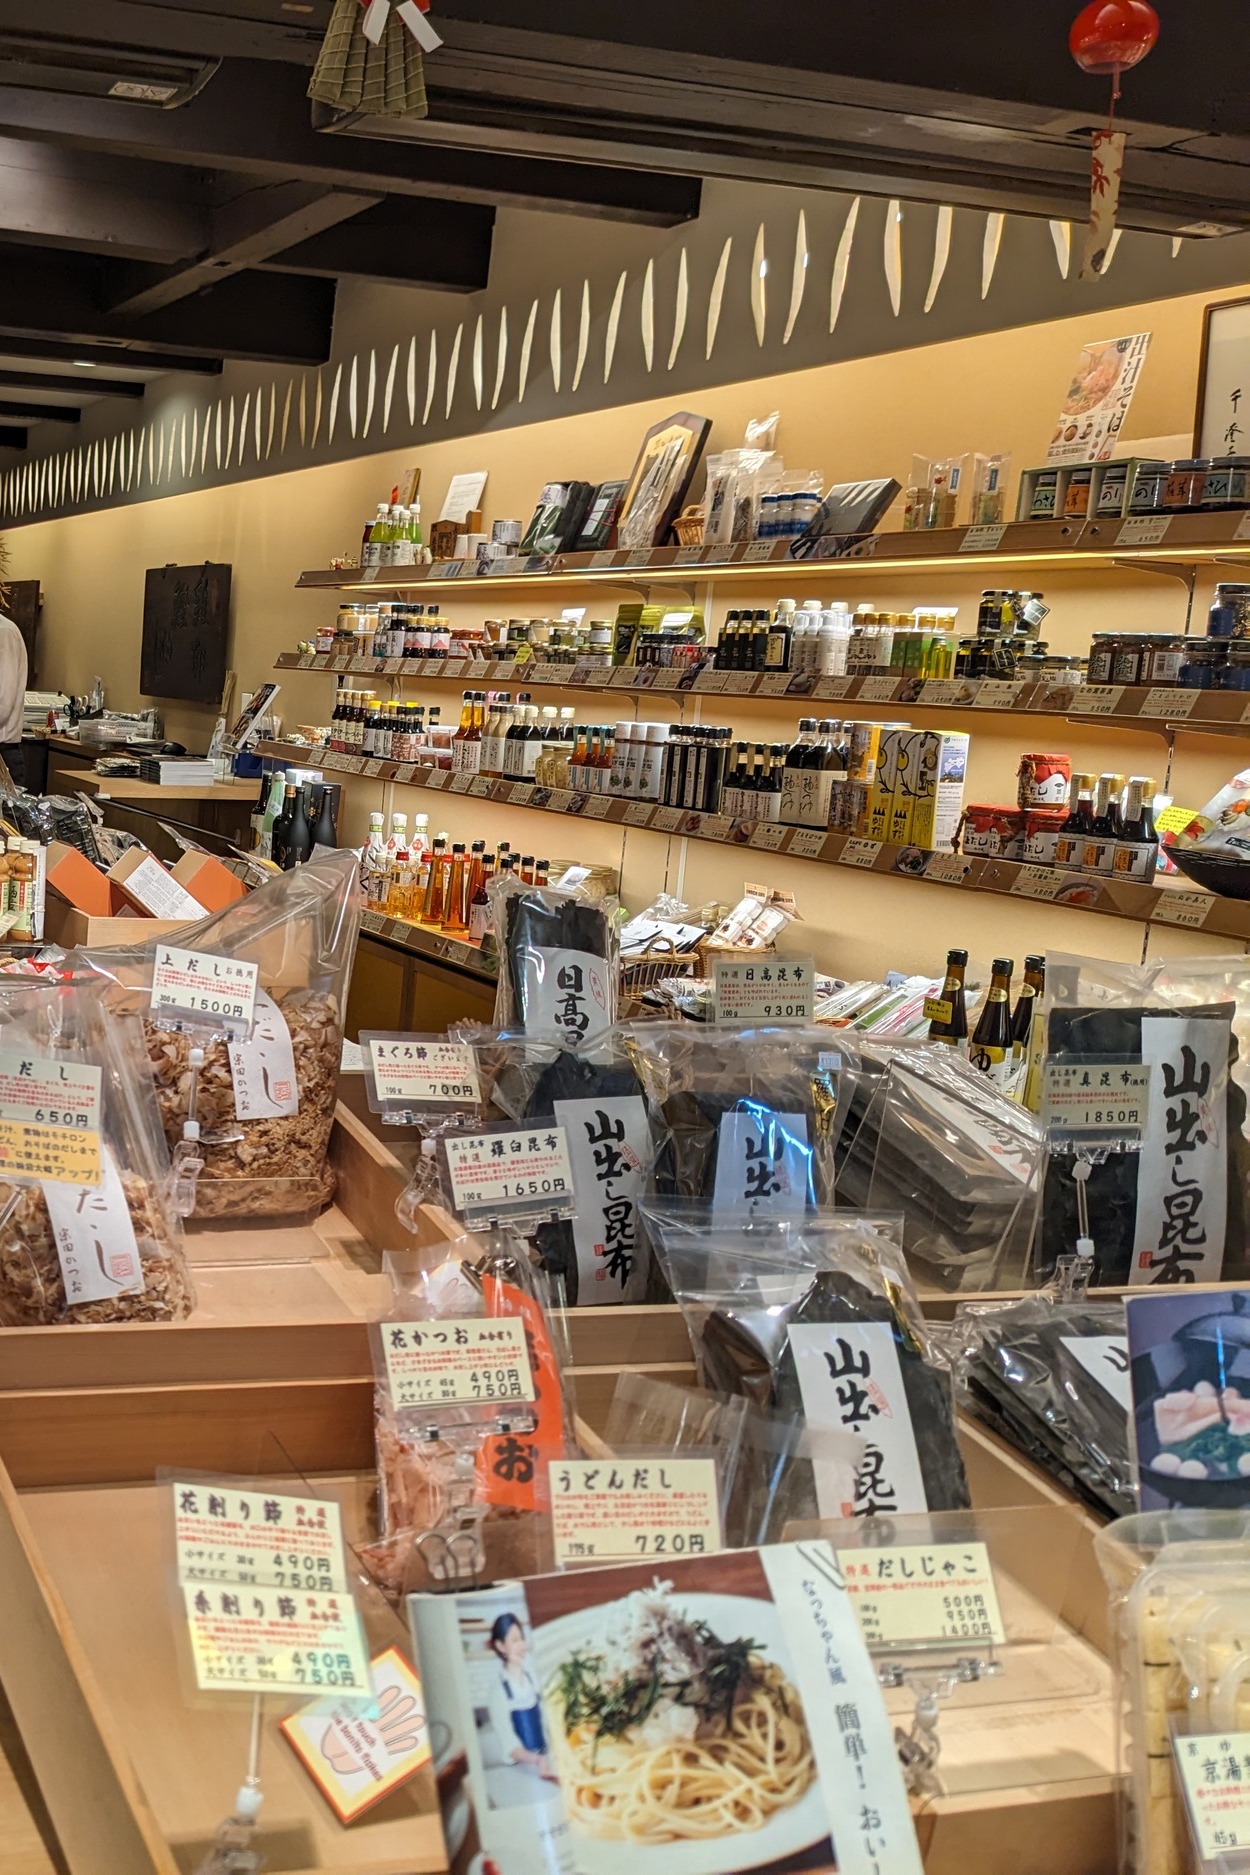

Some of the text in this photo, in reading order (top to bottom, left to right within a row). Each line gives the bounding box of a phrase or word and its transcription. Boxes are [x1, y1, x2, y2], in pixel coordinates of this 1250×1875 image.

[160, 953, 254, 979] 上だし お徳用
[745, 966, 804, 981] 日高昆布
[189, 996, 243, 1017] 1500円
[764, 1005, 805, 1016] 930円
[377, 1045, 428, 1060] まぐろ節
[1079, 1070, 1132, 1087] 真昆布
[429, 1084, 473, 1096] 700円
[35, 1109, 88, 1127] 650円
[1085, 1110, 1138, 1122] 1850円
[451, 1133, 558, 1158] 出し昆布 羅臼昆布
[458, 1152, 482, 1164] 特選
[1150, 1044, 1212, 1286] 山出し昆布
[502, 1178, 565, 1198] 1650円
[584, 1109, 635, 1290] 山出し昆布
[390, 1327, 469, 1349] 花かつお
[470, 1369, 519, 1383] 490円
[472, 1382, 522, 1398] 750円
[558, 1468, 672, 1492] うどんだし
[179, 1489, 283, 1525] 花削り節
[635, 1534, 705, 1553] 720円
[272, 1553, 332, 1573] 490円
[877, 1554, 978, 1579] だしじゃこ
[274, 1571, 333, 1591] 750円
[943, 1594, 984, 1609] 500円
[946, 1608, 988, 1622] 950円
[941, 1622, 992, 1637] 1400円
[290, 1652, 351, 1669] 490円
[294, 1669, 355, 1687] 750円
[339, 1723, 365, 1756] bonito
[360, 1751, 385, 1783] flakes
